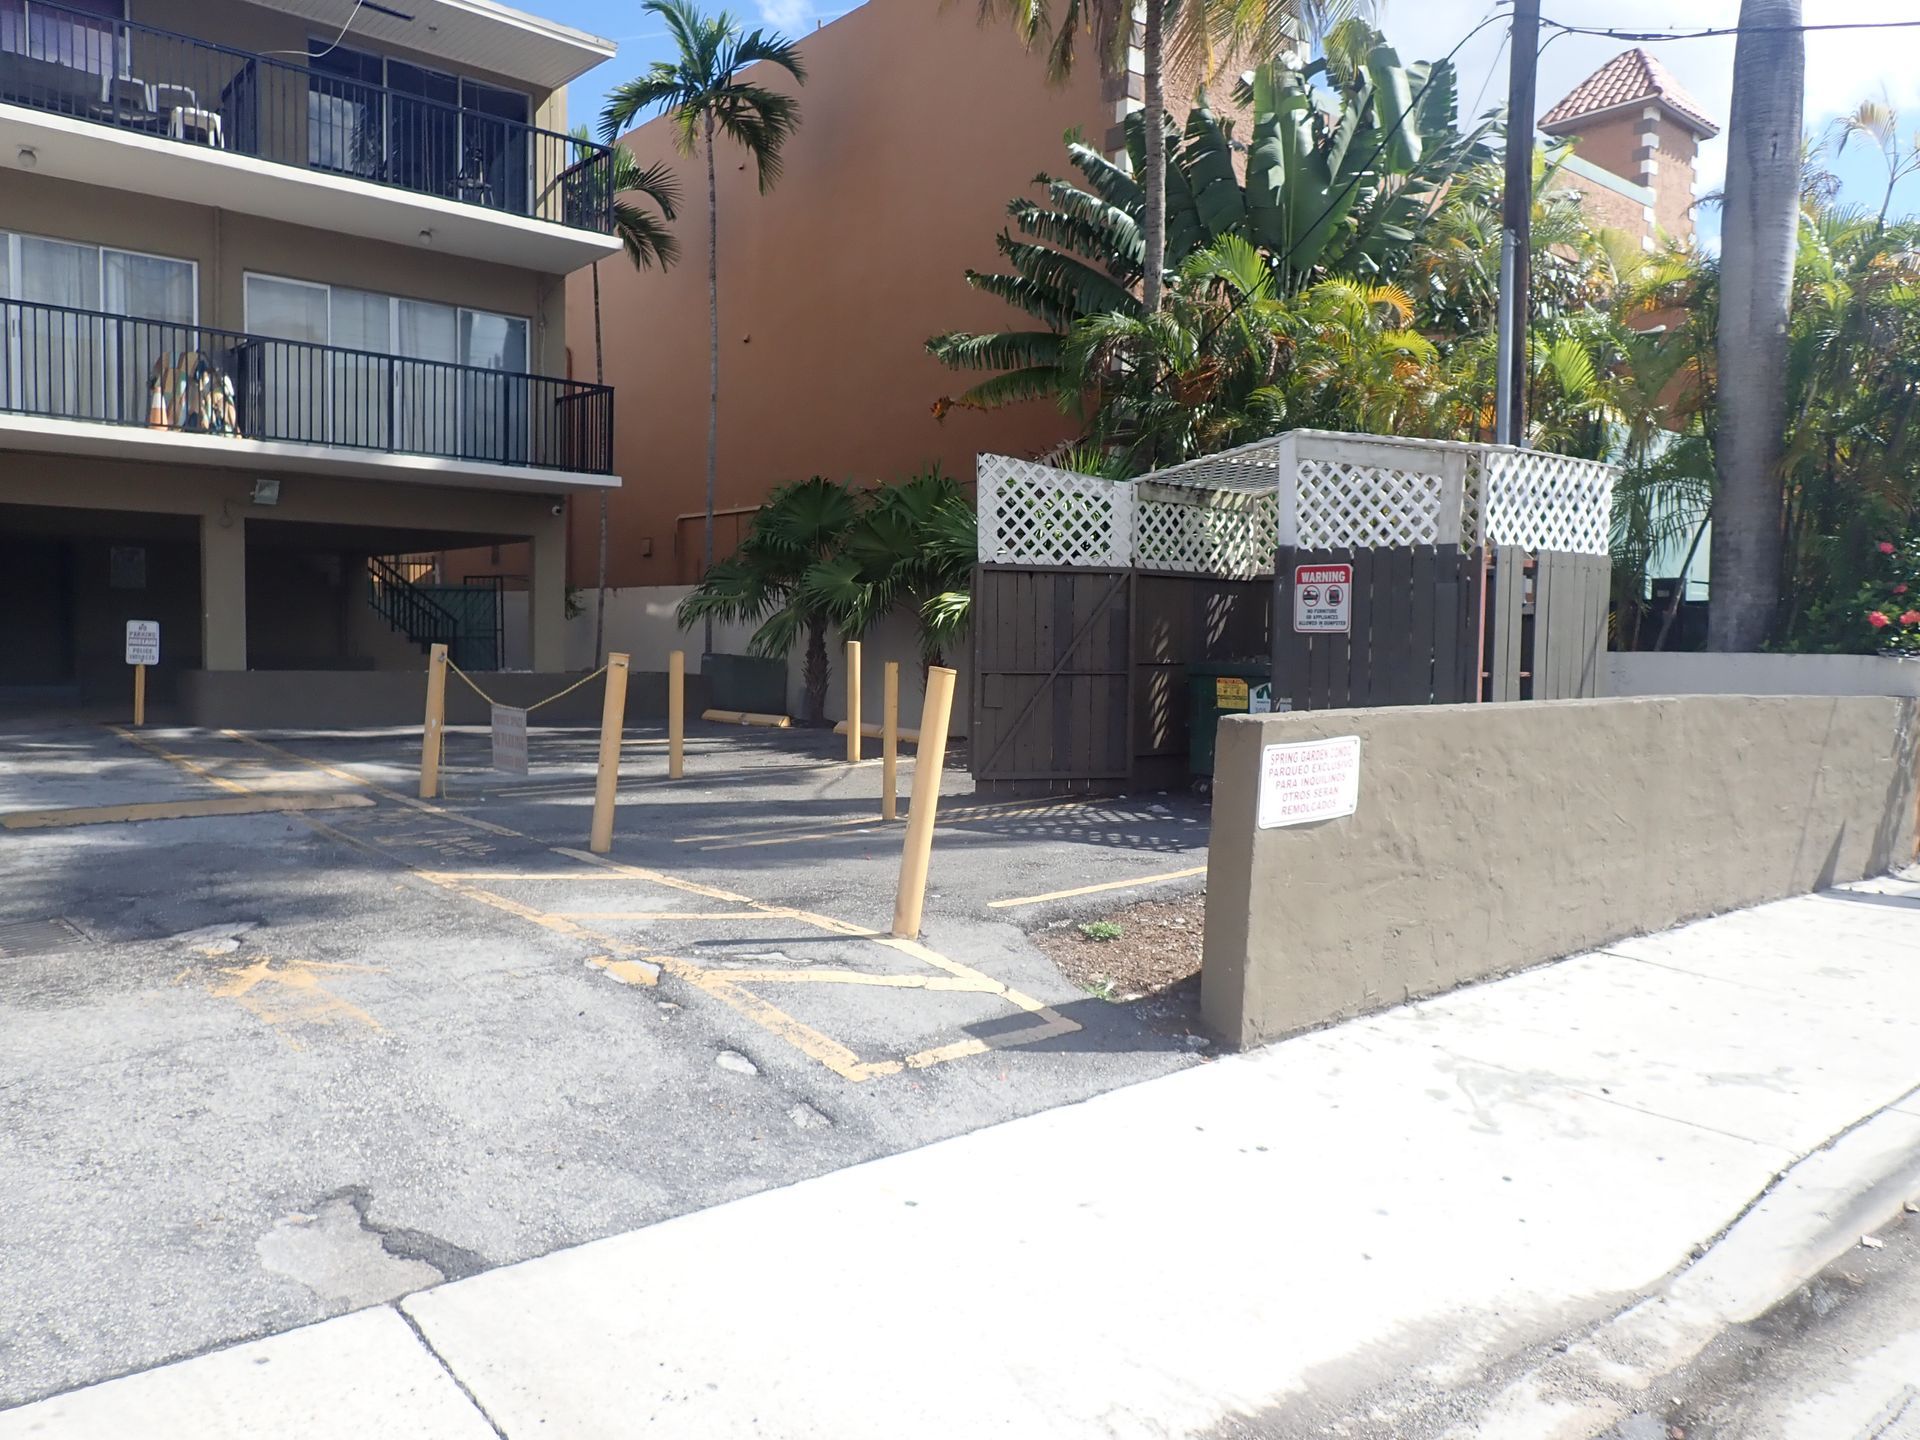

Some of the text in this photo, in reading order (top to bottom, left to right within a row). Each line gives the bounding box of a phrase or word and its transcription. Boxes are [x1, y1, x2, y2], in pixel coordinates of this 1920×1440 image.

[1301, 571, 1346, 583] WARNING
[1270, 752, 1299, 766] SPRING
[1300, 749, 1328, 763] GARDEN
[1268, 758, 1354, 778] PARQUEO EXCLUSIVO
[1275, 773, 1346, 790] PARA INQUILINOS
[1282, 786, 1339, 802] OTROS SERAN
[1280, 799, 1337, 816] REMOLCADOS
